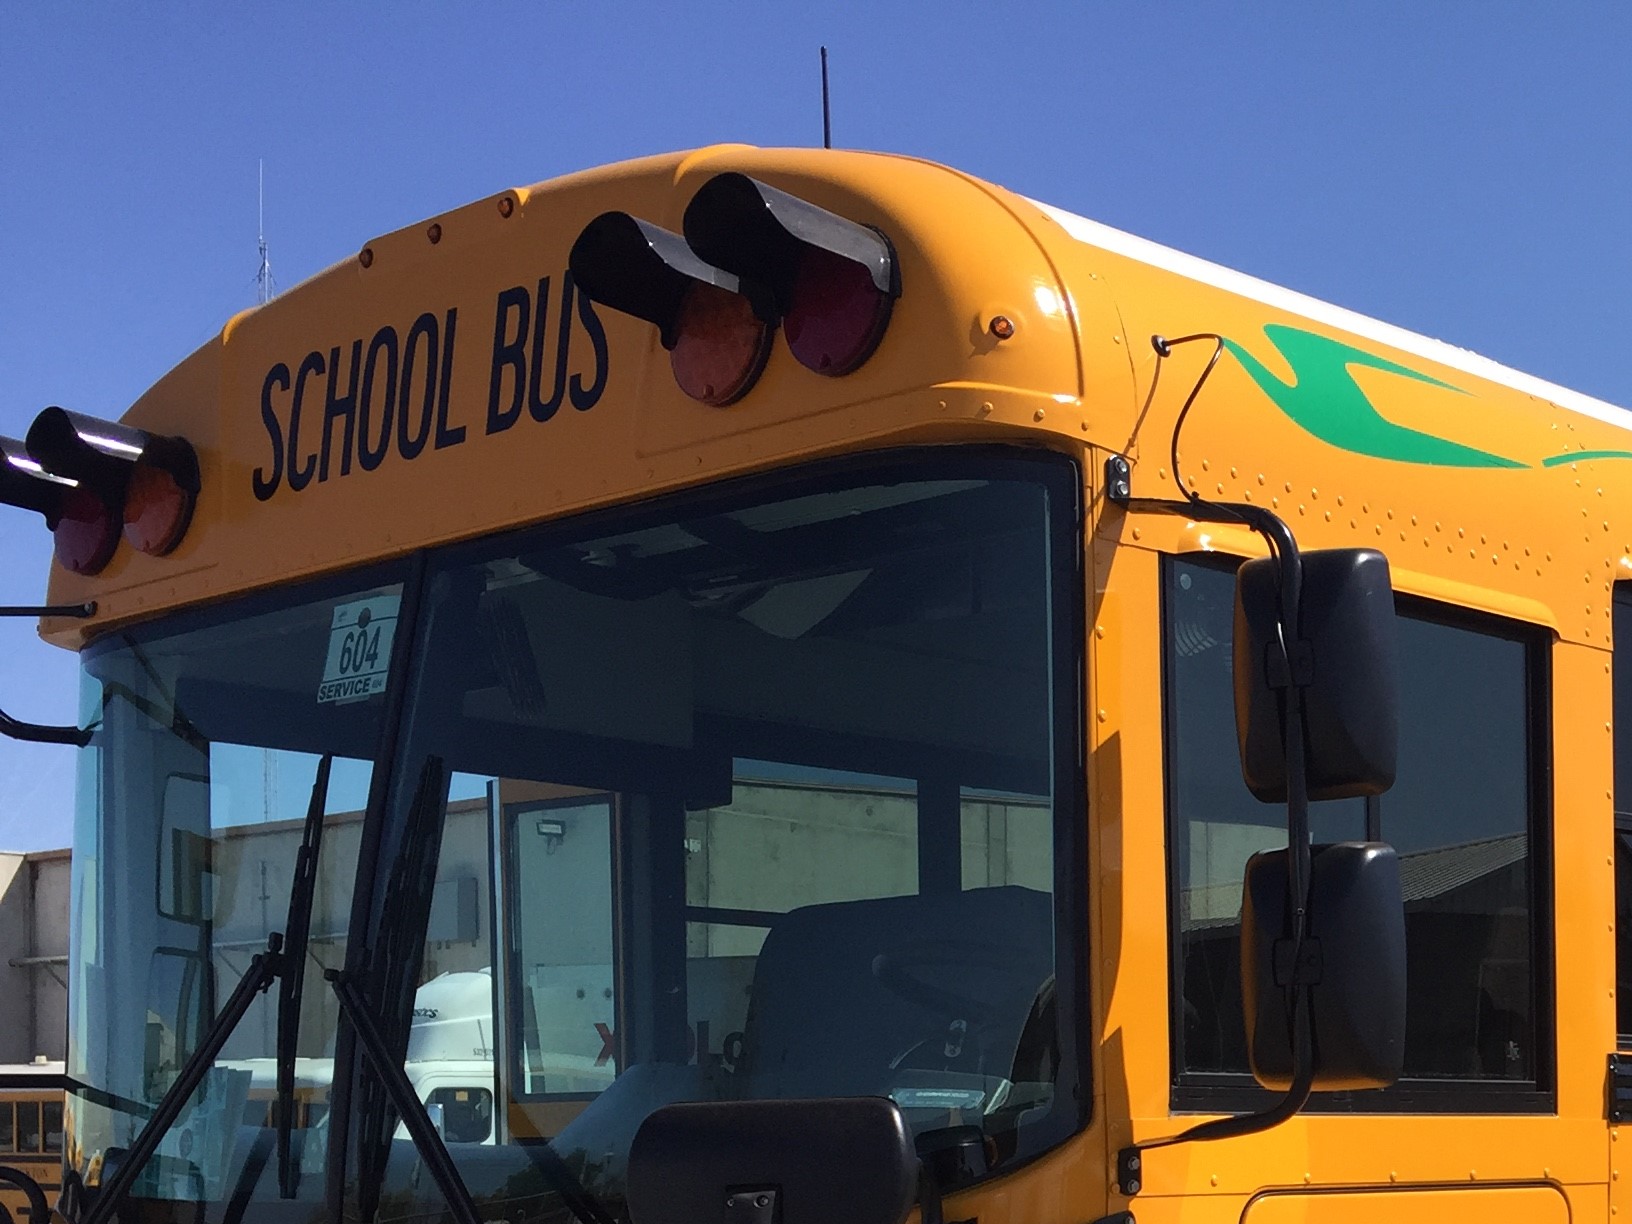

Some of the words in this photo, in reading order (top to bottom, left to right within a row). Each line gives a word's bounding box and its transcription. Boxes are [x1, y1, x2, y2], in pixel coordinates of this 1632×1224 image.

[252, 307, 466, 502] SCHOOL
[485, 269, 609, 435] BUS
[339, 626, 381, 675] 604
[318, 677, 372, 701] SERVICE
